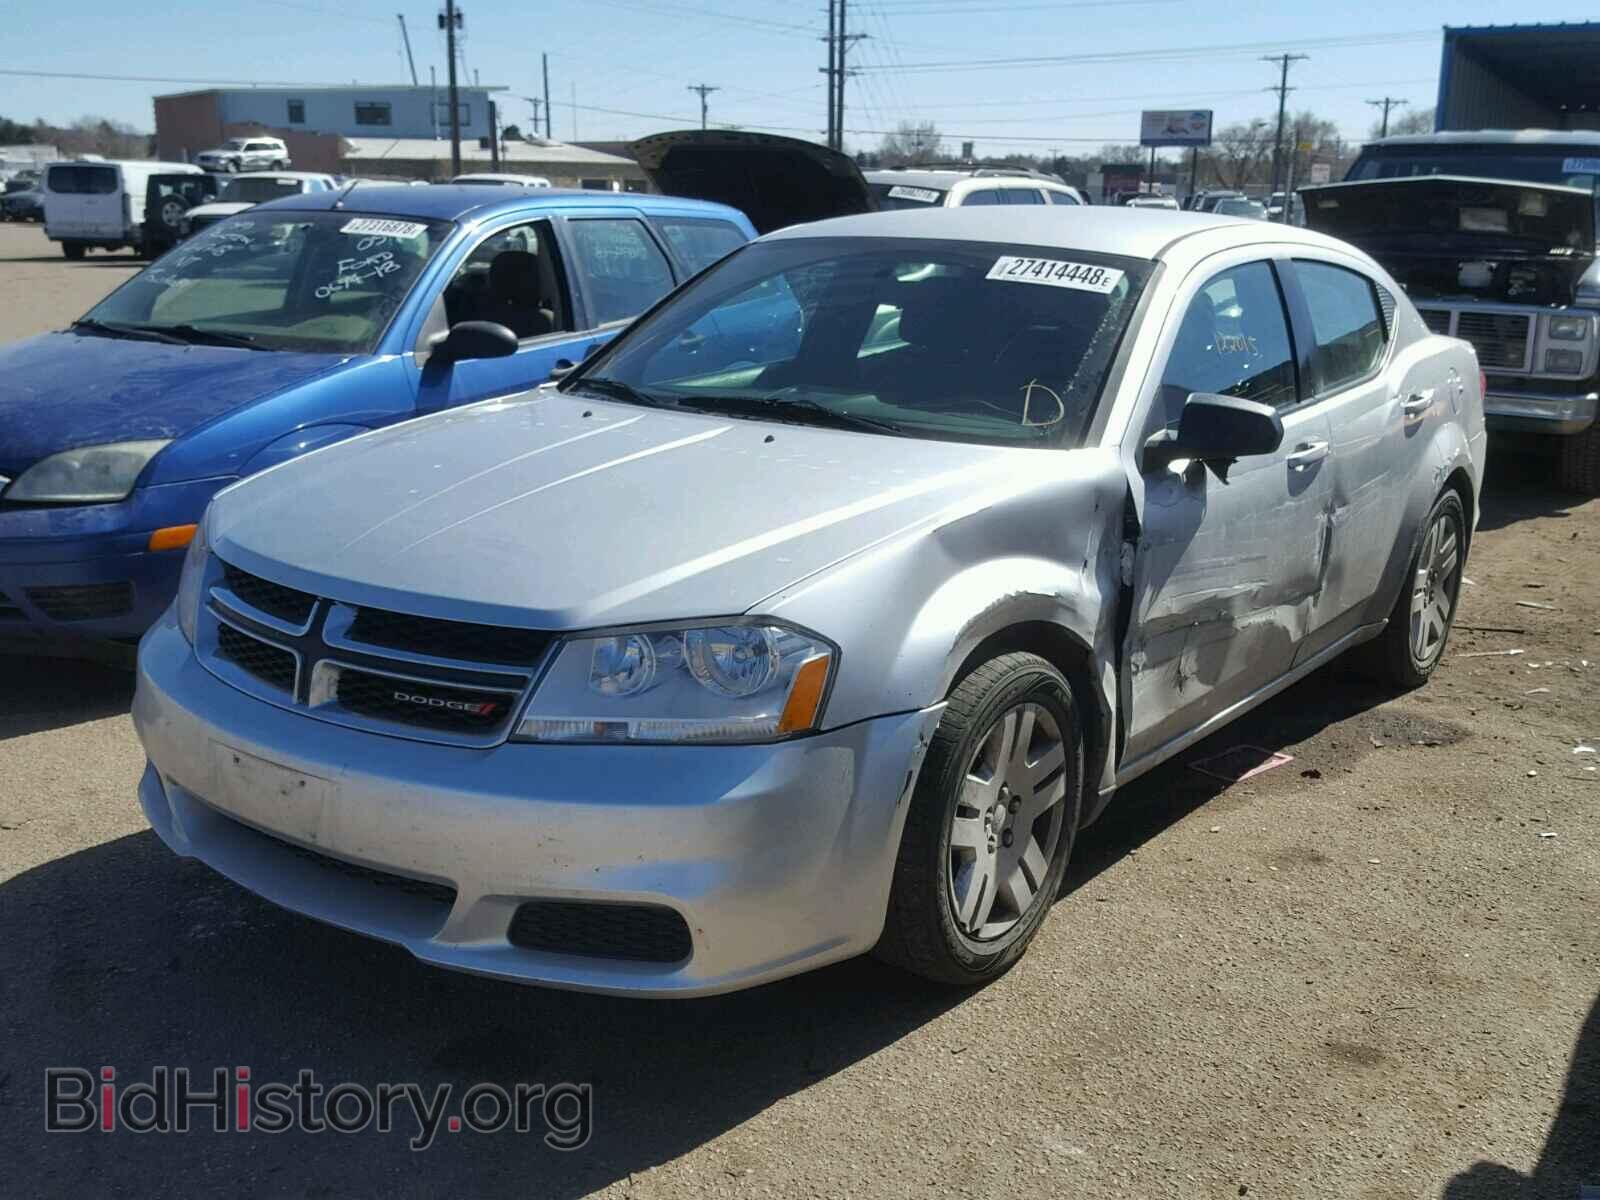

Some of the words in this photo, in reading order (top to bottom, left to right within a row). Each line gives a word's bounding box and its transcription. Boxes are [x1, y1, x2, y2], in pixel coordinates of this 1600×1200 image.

[1007, 259, 1105, 286] 27414448
[1019, 378, 1065, 427] D
[394, 691, 481, 713] DODGE
